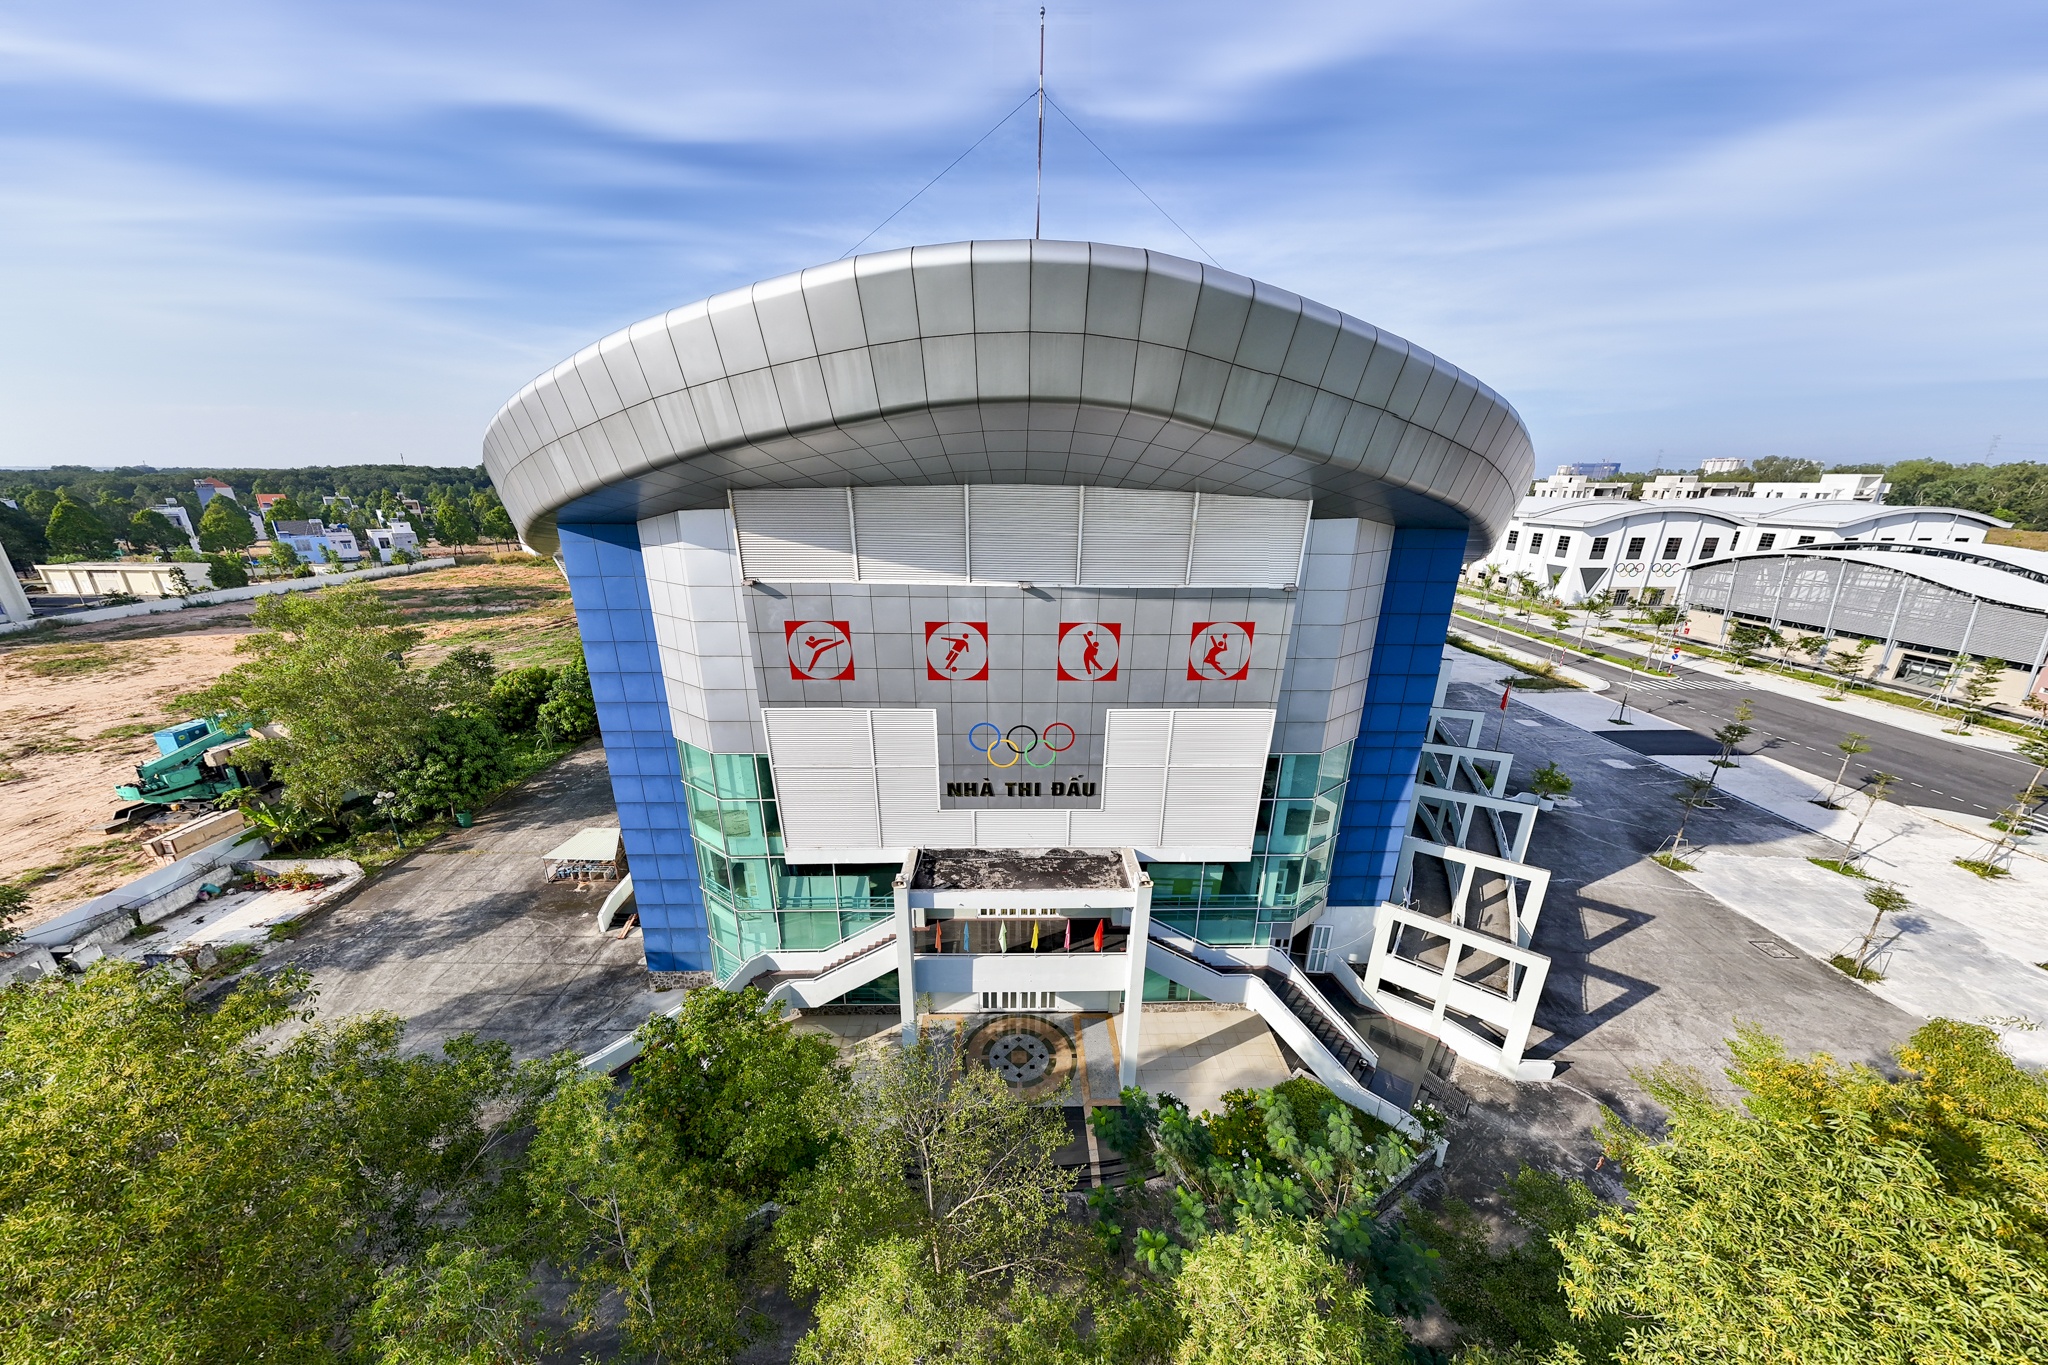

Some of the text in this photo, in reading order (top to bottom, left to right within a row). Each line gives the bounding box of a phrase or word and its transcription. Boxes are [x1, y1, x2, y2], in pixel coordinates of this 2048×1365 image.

[947, 775, 1096, 797] NHÀ THI ĐẤU
